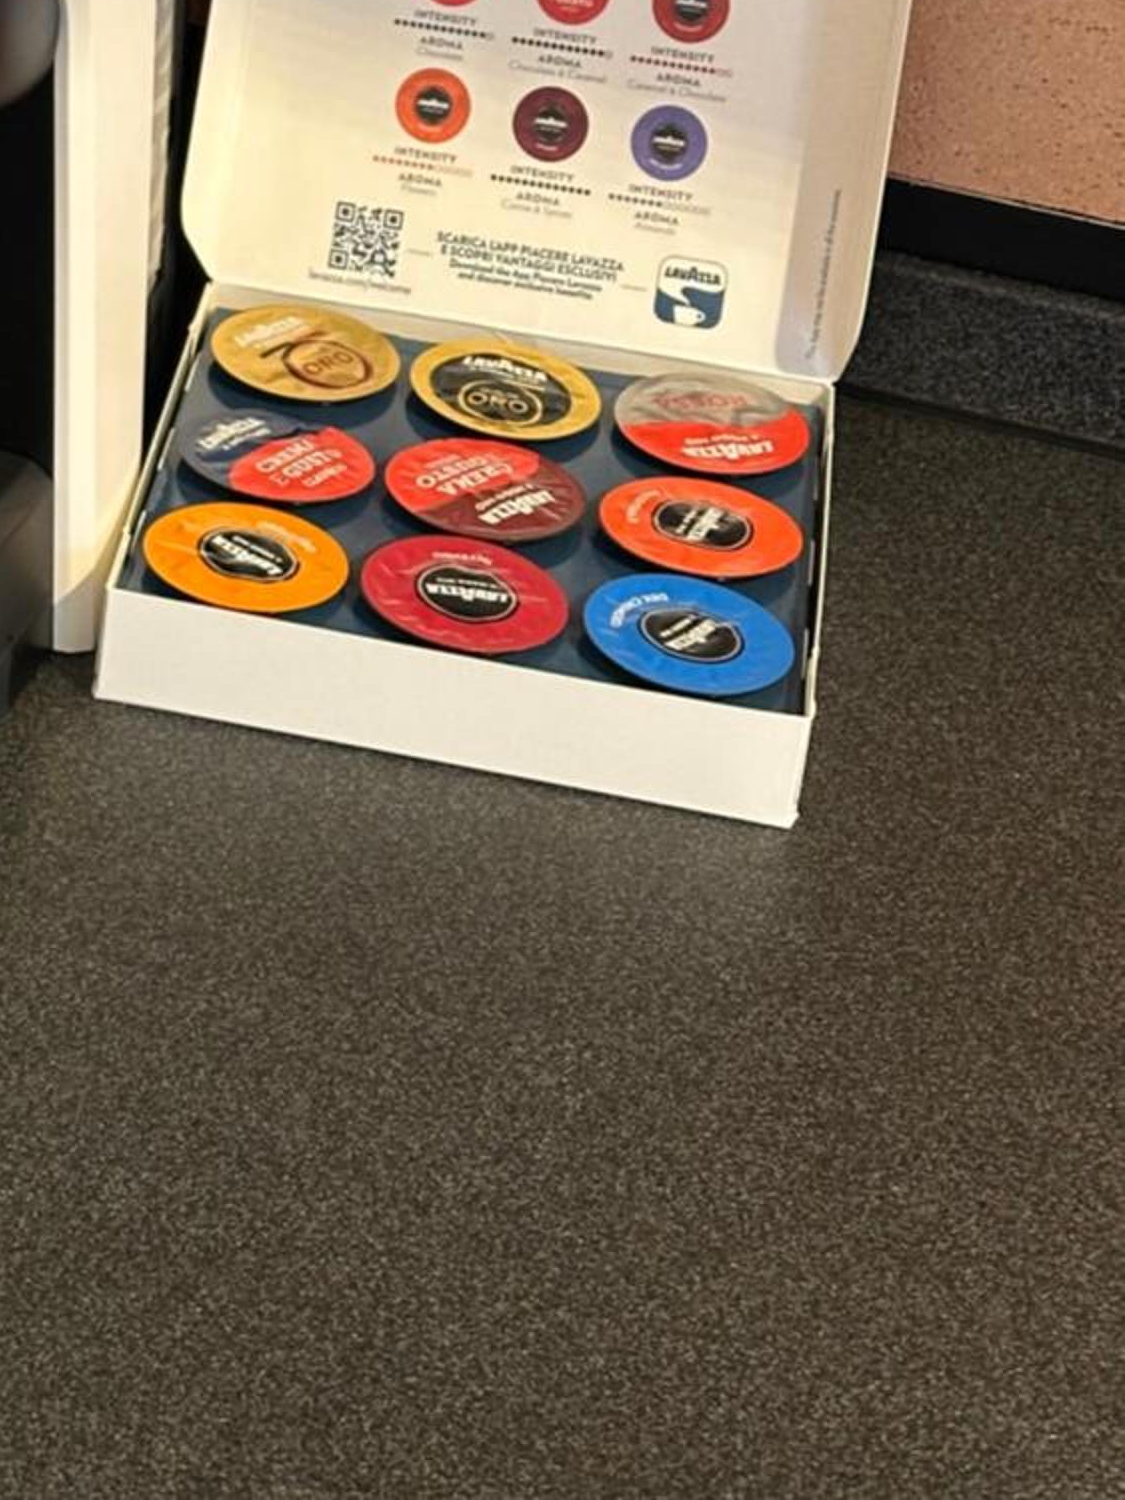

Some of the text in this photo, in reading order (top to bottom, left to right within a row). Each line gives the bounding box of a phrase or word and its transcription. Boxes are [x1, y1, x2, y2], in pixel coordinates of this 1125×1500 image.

[414, 10, 477, 26] INTENSITY
[421, 36, 463, 50] AROMA
[534, 27, 596, 44] INTENSITY
[539, 55, 581, 68] AROMA
[651, 47, 714, 63] INTENSITY
[657, 73, 701, 87] AROMA
[394, 147, 457, 164] INTENSITY
[399, 173, 443, 187] AROMA
[511, 165, 575, 183] INTENSITY
[516, 192, 560, 206] AROMA
[629, 184, 693, 200] INTENSITY
[634, 211, 679, 226] AROMA
[437, 230, 486, 249] SCARICA
[571, 253, 624, 272] LAVAZZA
[496, 253, 555, 272] VANTAGGI
[665, 266, 721, 286] LAVAZZA
[302, 350, 354, 375] ORO
[463, 356, 548, 382] LAVAZZA
[468, 392, 528, 414] ORO
[682, 440, 774, 460] LAVAZZA
[436, 463, 514, 496] CREMA
[425, 582, 508, 603] LAVAZZA
